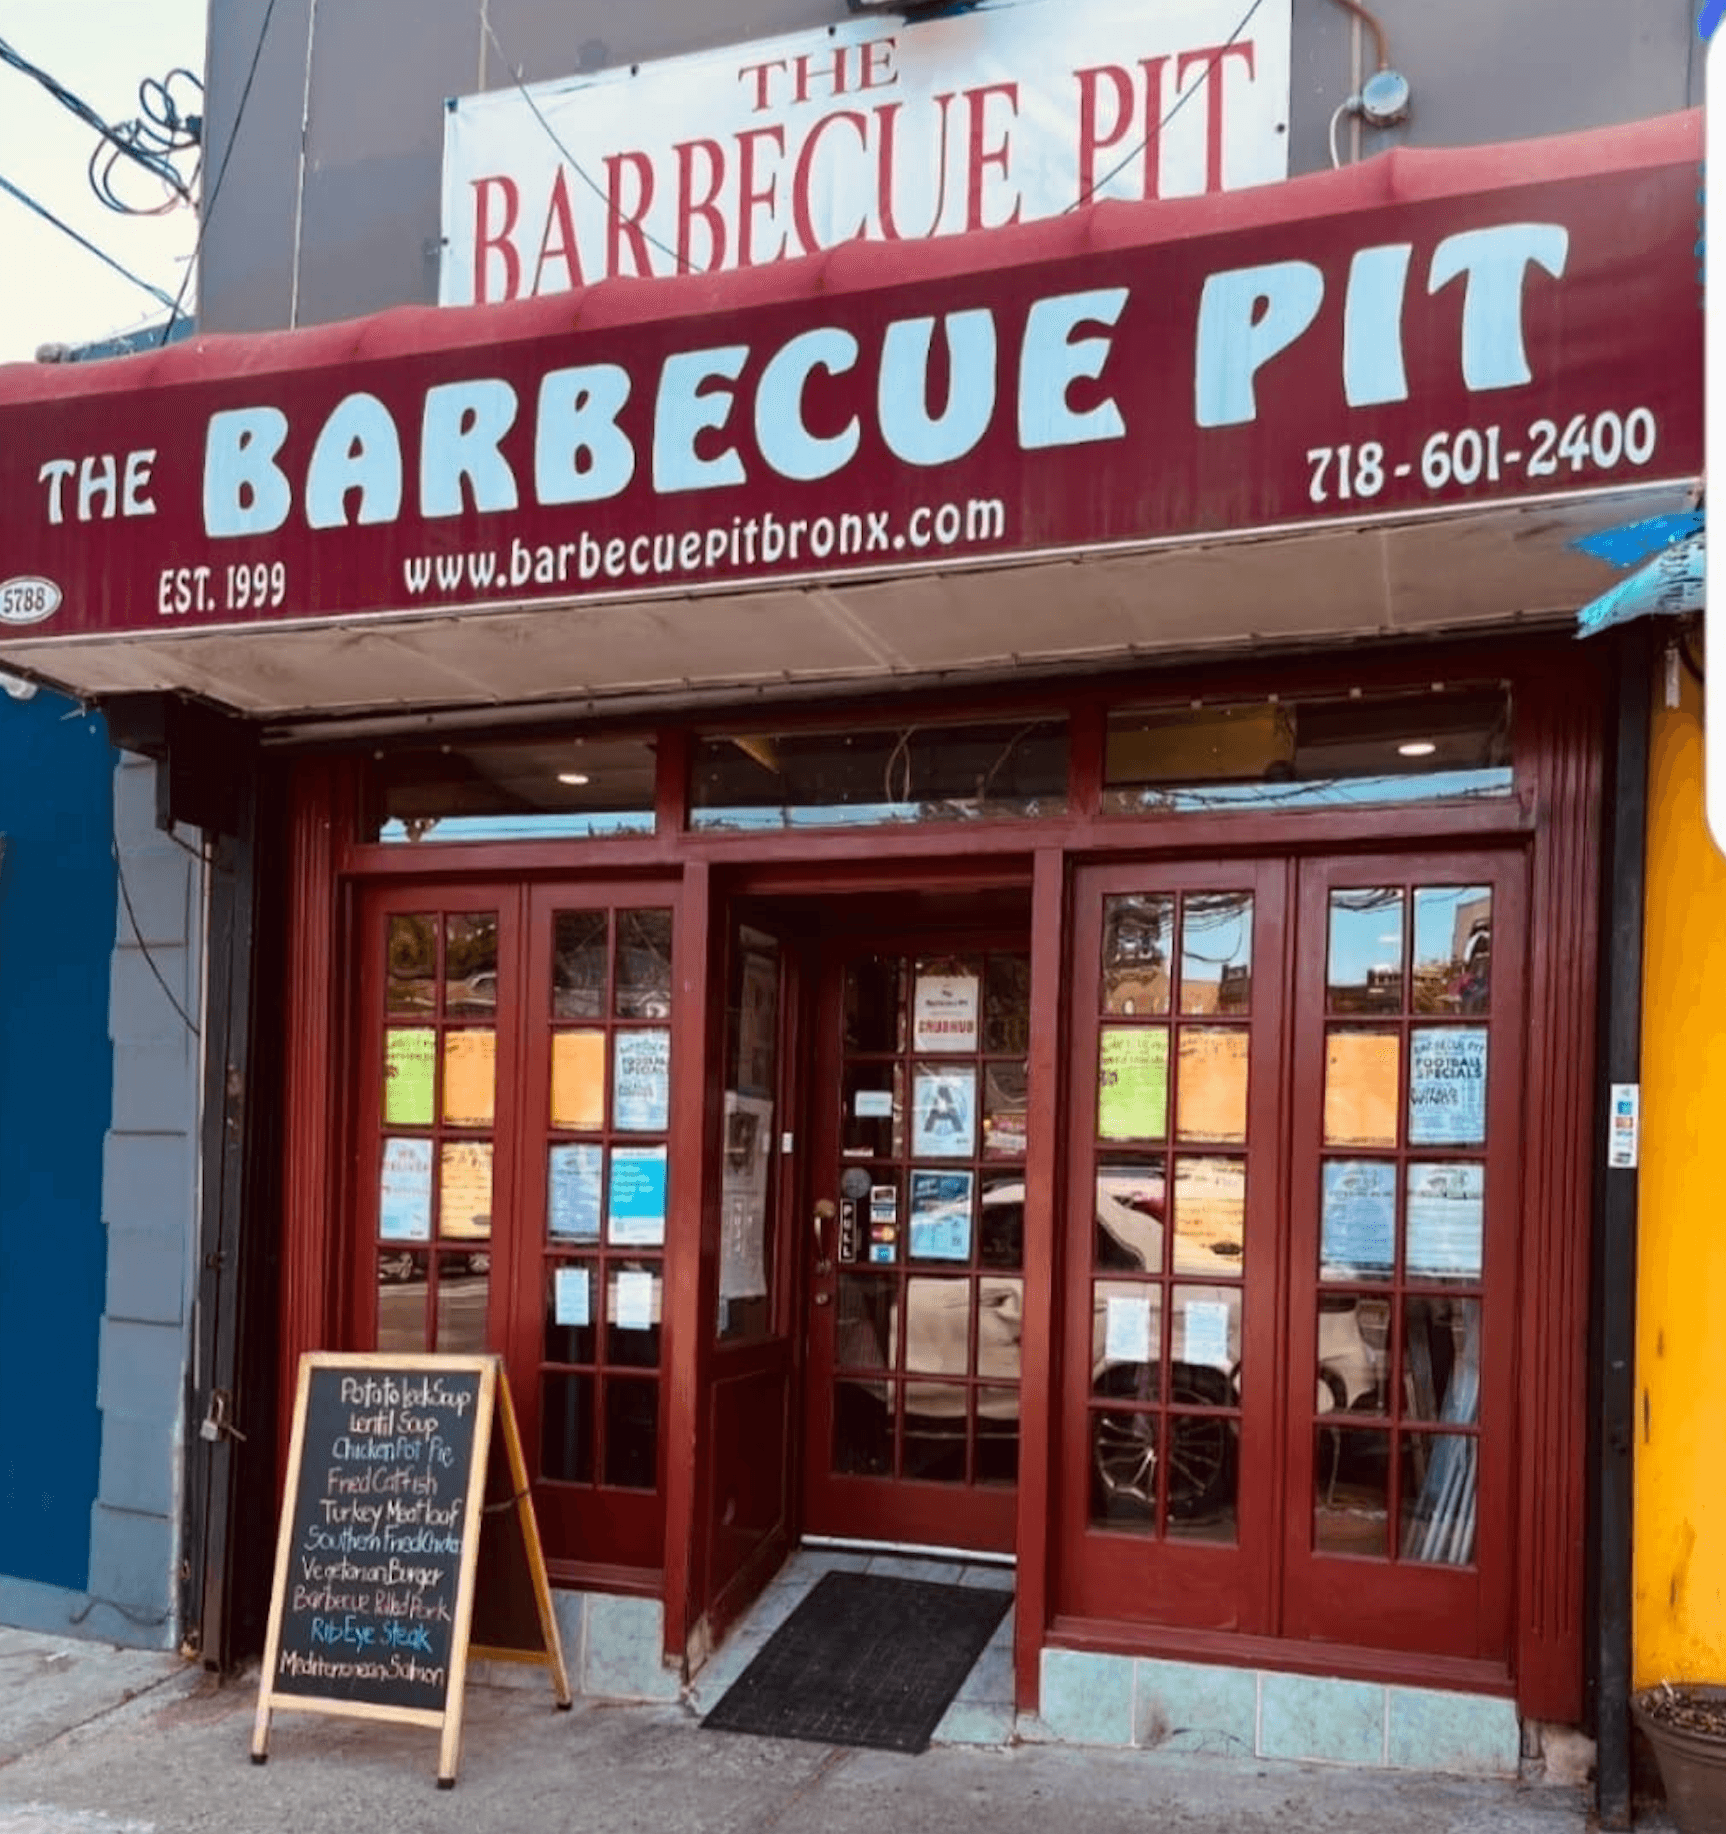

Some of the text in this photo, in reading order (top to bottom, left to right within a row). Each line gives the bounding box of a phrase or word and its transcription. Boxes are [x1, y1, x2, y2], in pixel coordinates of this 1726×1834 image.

[738, 37, 899, 111] THE
[469, 41, 1257, 305] BARBECUE PIT
[38, 222, 1570, 538] THE BARBECUE PIT
[403, 496, 1006, 595] www.barbecuepitbronx.com
[3, 586, 47, 614] 5788
[158, 560, 287, 615] EST. 1999
[923, 1085, 963, 1133] A
[341, 1376, 400, 1408] Potato
[432, 1377, 472, 1417] Soup
[397, 1410, 439, 1442] Soup
[332, 1436, 395, 1461] Chicken
[428, 1435, 455, 1468] Pie
[327, 1465, 372, 1495] Fried
[319, 1497, 383, 1538] Turkey
[303, 1524, 381, 1553] Southern
[302, 1555, 445, 1595] Vegetarian Burger
[293, 1584, 370, 1613] Barbecue
[380, 1619, 434, 1654] Steak
